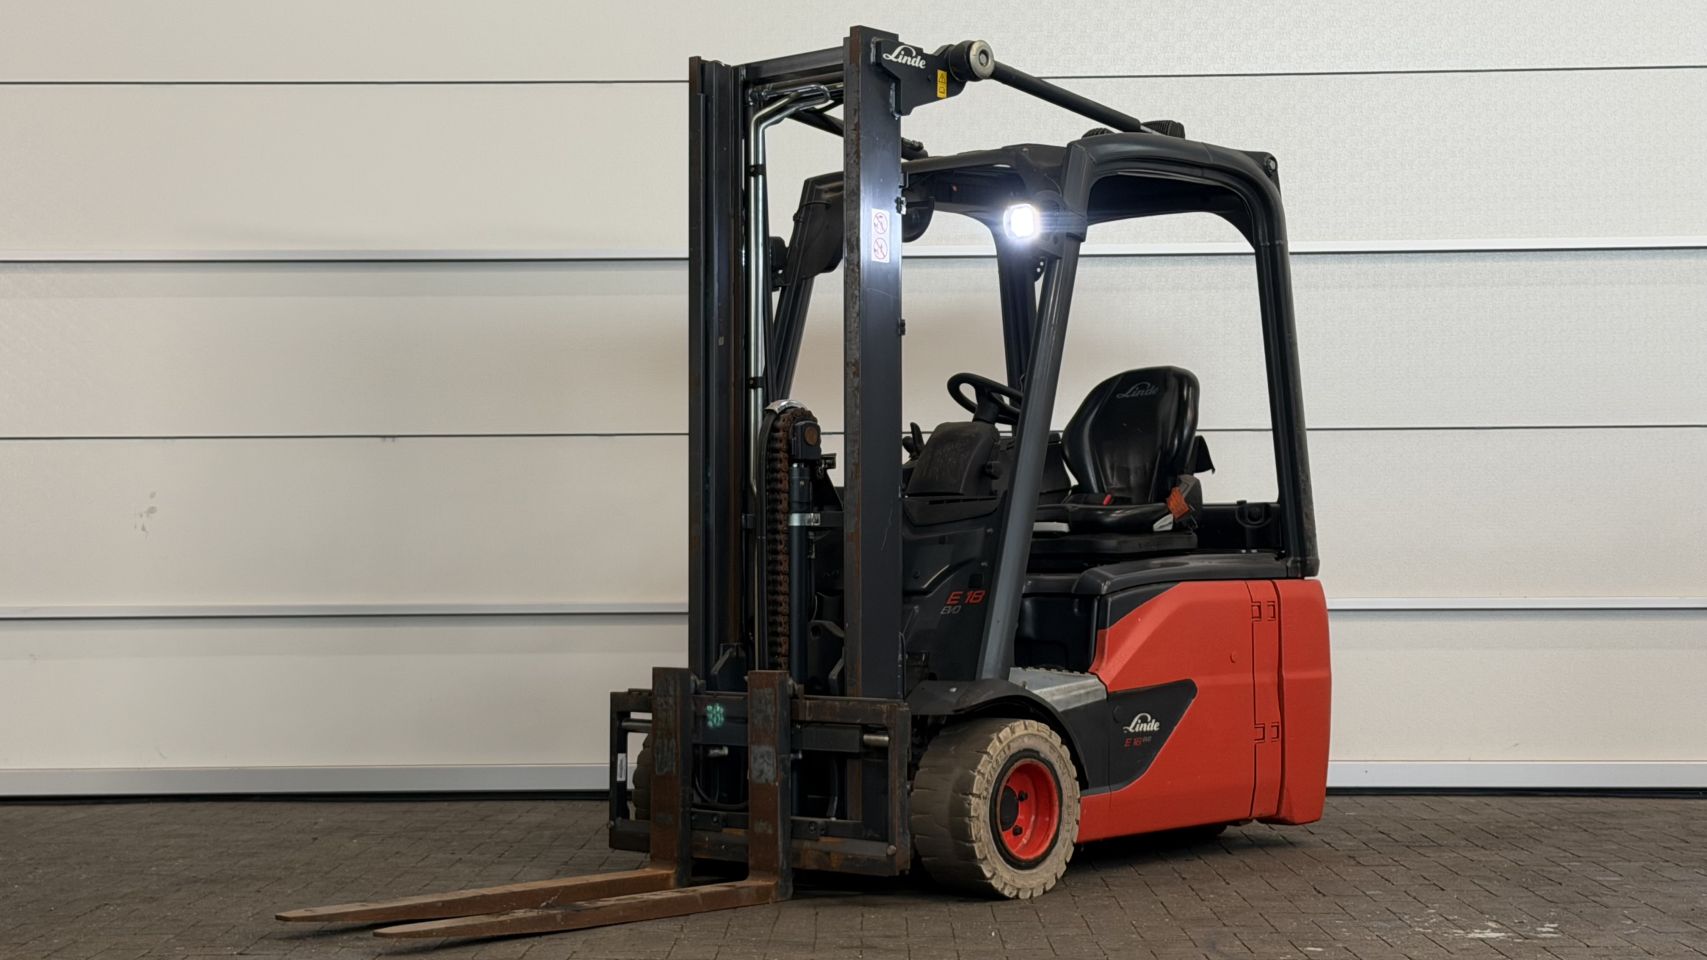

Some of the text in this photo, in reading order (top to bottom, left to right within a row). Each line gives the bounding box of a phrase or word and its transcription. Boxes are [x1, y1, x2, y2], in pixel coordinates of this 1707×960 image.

[882, 45, 927, 69] Linde
[946, 591, 963, 605] E
[1122, 712, 1161, 733] Linde
